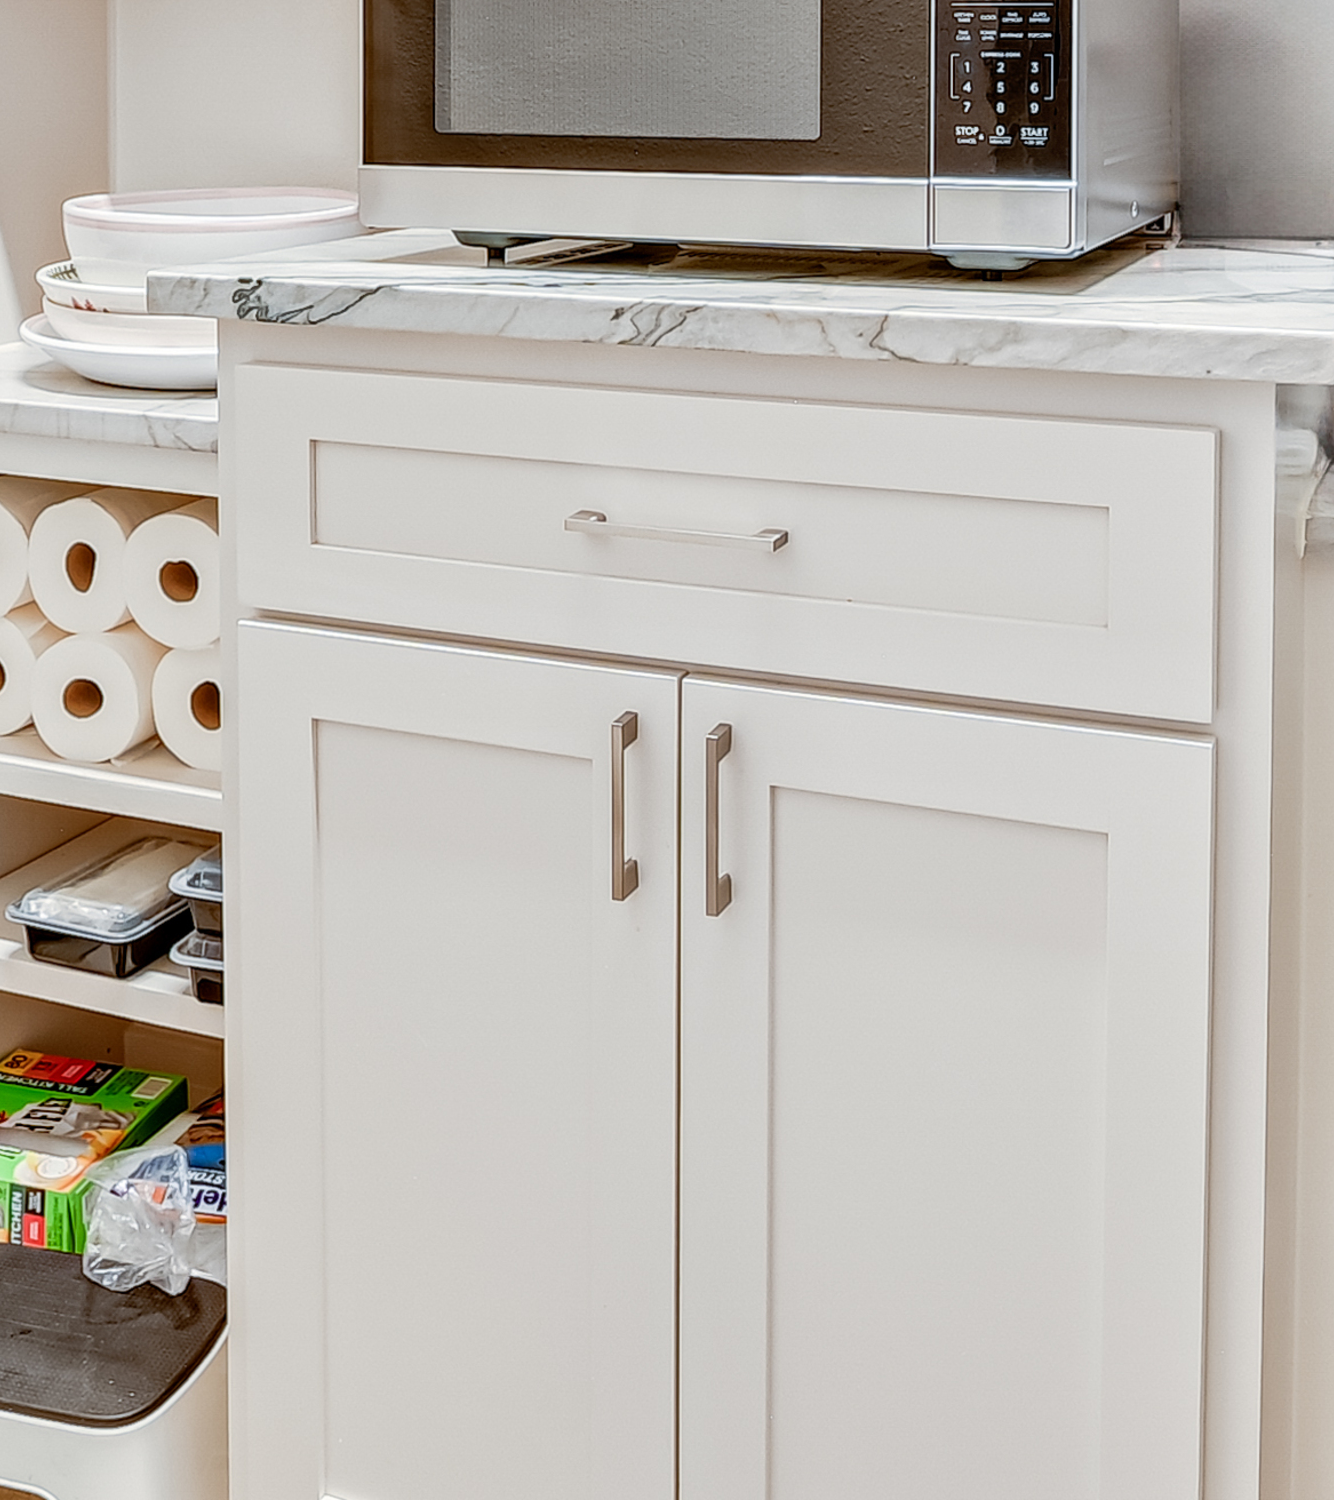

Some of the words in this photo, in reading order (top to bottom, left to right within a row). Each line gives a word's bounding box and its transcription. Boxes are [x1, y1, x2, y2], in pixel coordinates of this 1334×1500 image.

[963, 61, 971, 74] 1
[996, 61, 1005, 74] 2
[1030, 61, 1039, 74] 3
[962, 81, 972, 93] 4
[996, 81, 1005, 93] 5
[1030, 82, 1039, 93] 6
[962, 101, 972, 113] 7
[996, 101, 1005, 114] 8
[1030, 101, 1039, 114] 9
[954, 126, 979, 137] STOP
[995, 125, 1005, 137] 0
[1020, 126, 1049, 138] START
[186, 1169, 227, 1186] STOR
[10, 1190, 24, 1245] ITCHEN
